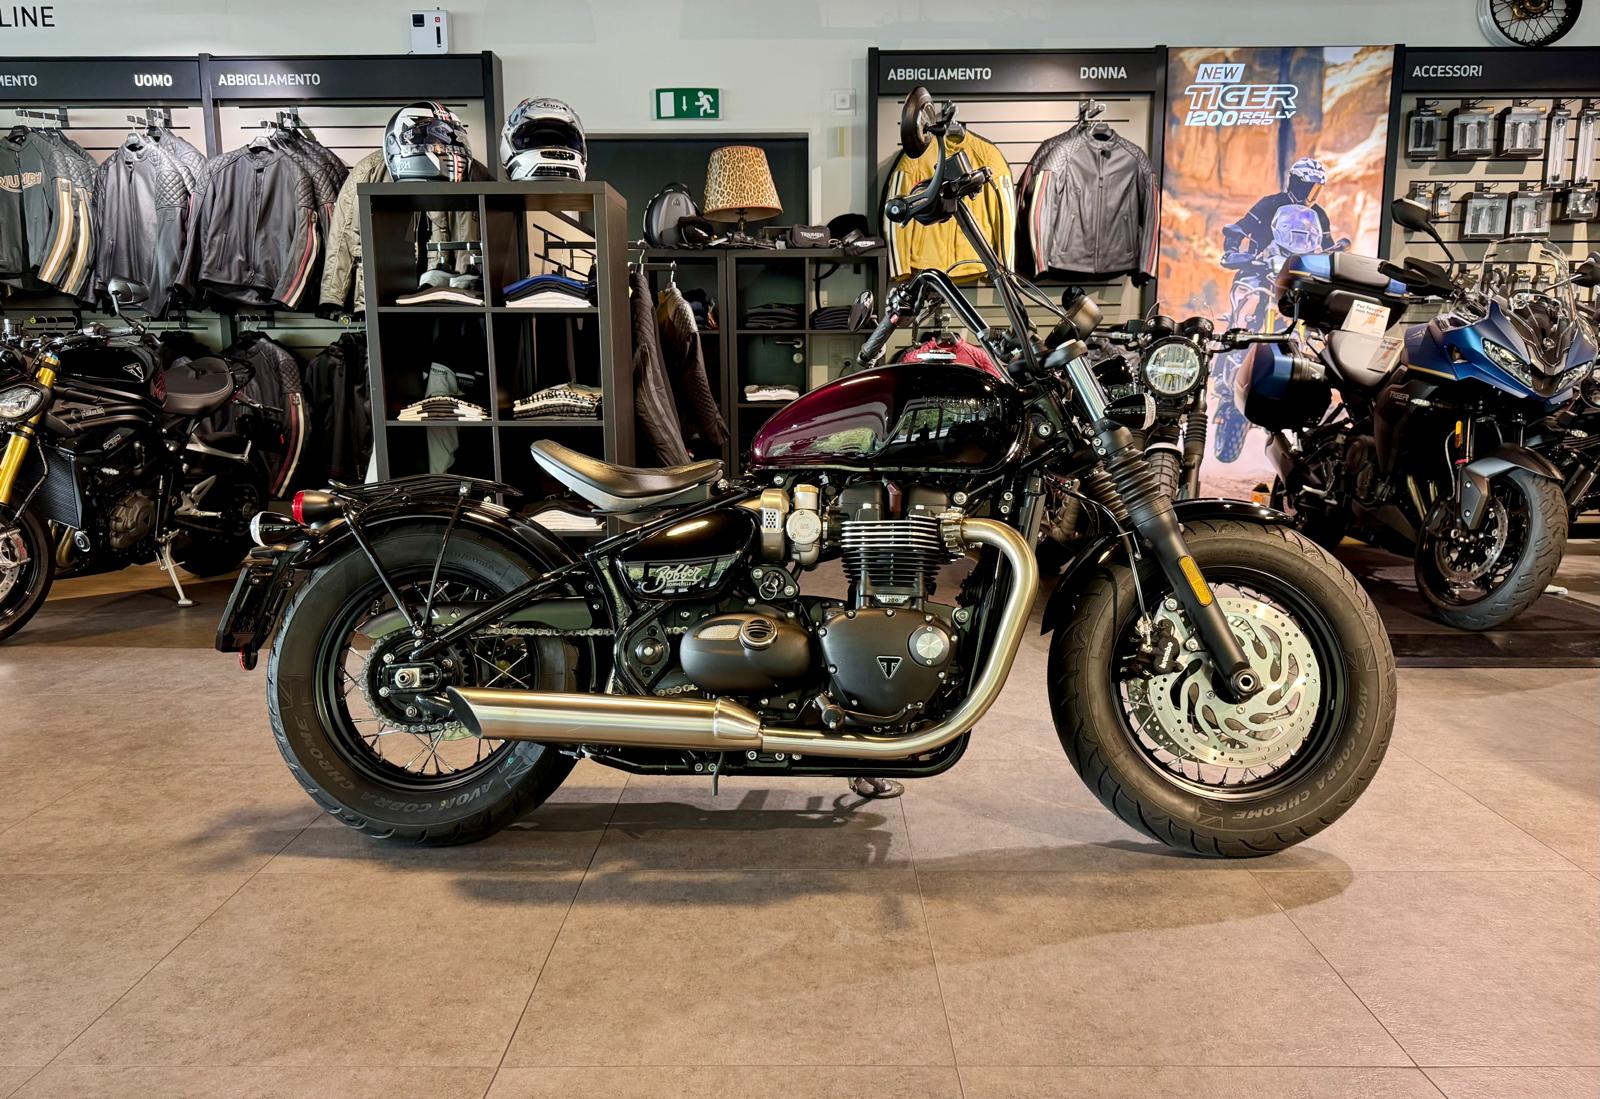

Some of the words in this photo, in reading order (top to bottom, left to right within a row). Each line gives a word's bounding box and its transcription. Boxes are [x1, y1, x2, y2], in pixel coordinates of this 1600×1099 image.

[0, 6, 56, 28] LINE
[887, 67, 992, 81] ABBIGLIAMENTO
[1080, 66, 1128, 80] DONNA
[1201, 66, 1240, 80] NEW
[1412, 64, 1483, 78] ACCESSORI
[134, 74, 173, 87] UOMO
[218, 73, 321, 86] ABBIGLIAMENTO
[1184, 84, 1299, 110] TIGER
[1184, 110, 1240, 127] 1200
[1239, 111, 1297, 119] RALLY
[1237, 118, 1274, 126] PRO
[1316, 738, 1356, 791] COBRA
[1231, 789, 1311, 820] CHROME
